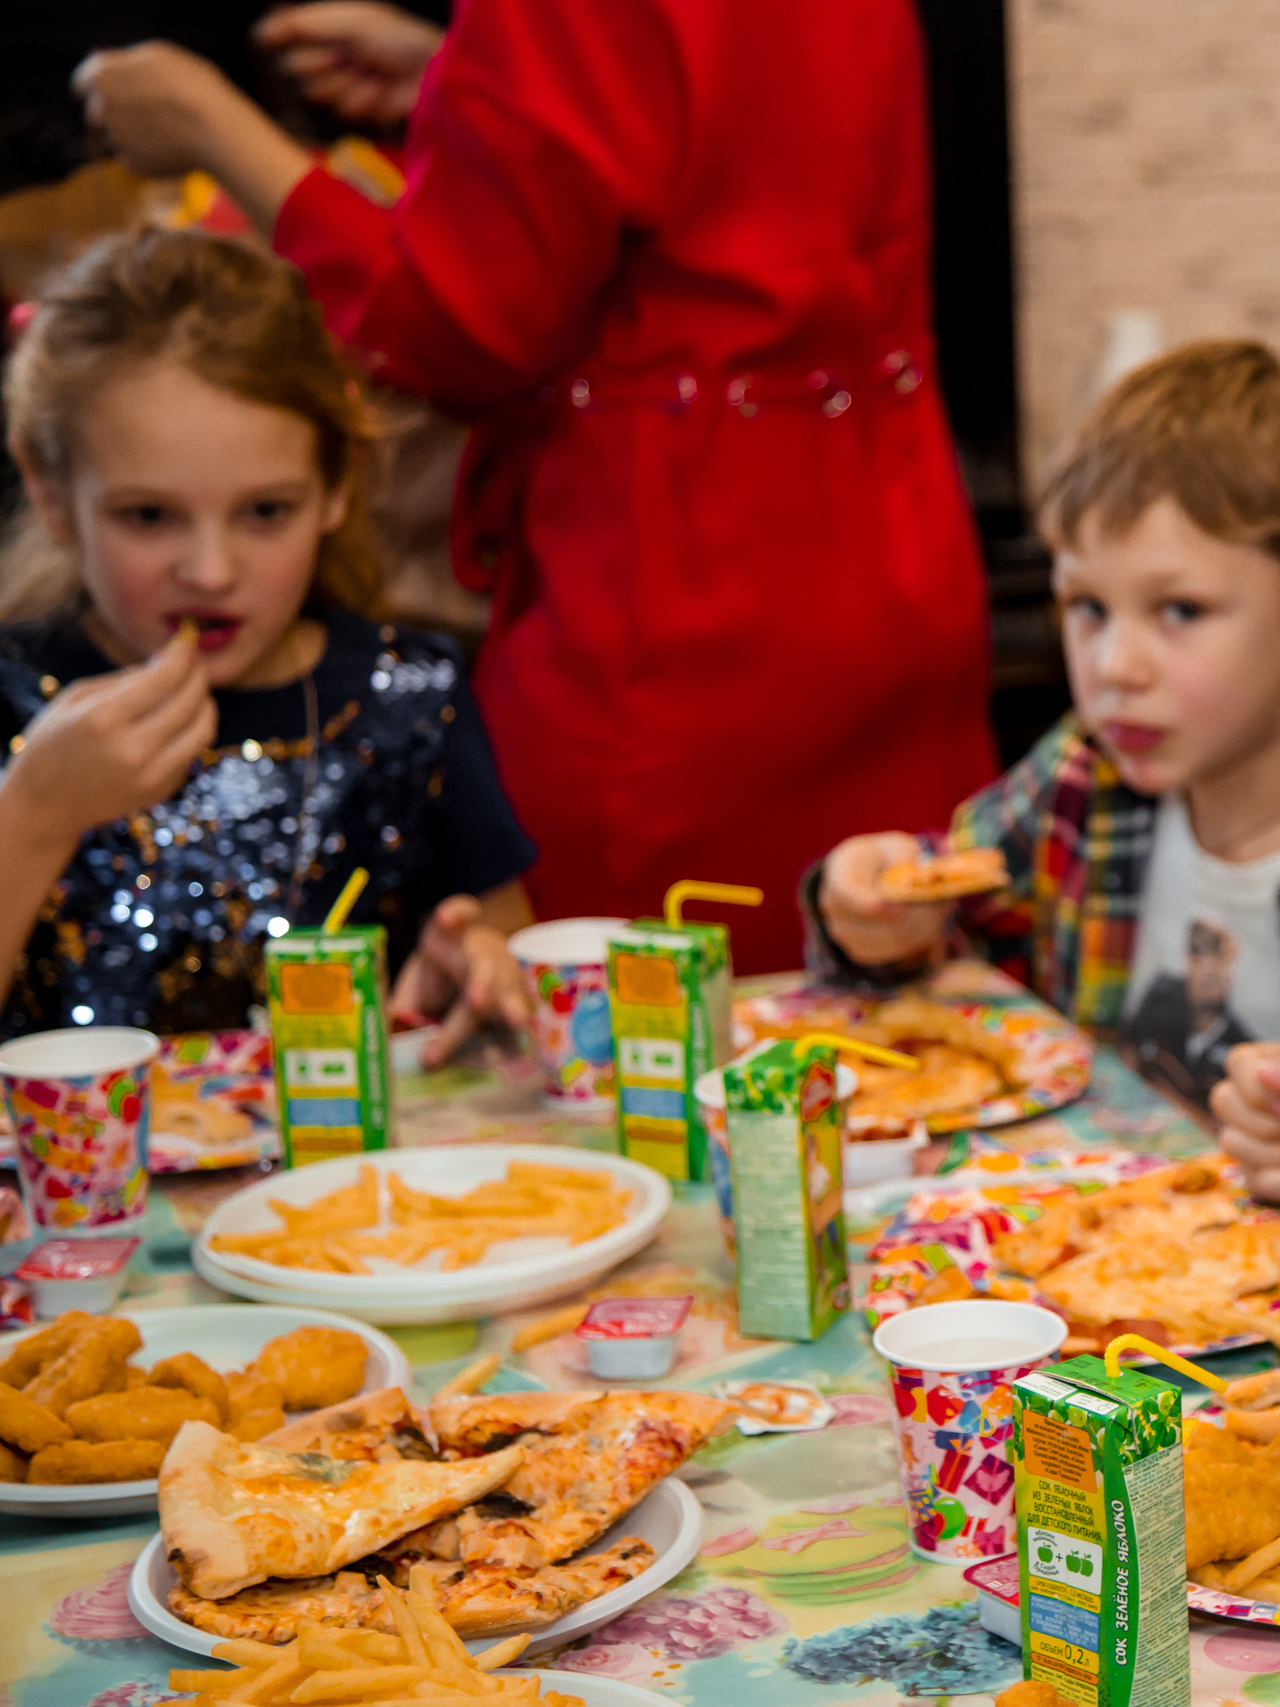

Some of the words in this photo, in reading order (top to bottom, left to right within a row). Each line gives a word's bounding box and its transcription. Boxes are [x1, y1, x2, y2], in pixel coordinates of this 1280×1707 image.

[1032, 1490, 1042, 1501] ИЗ
[1074, 1502, 1095, 1517] ЯБЛОК
[1038, 1480, 1051, 1491] СОК
[1054, 1484, 1087, 1503] ЯБЛОЧНЫЙ
[1026, 1512, 1041, 1525] ДЛЯ
[1041, 1516, 1072, 1533] ДЕТСКОГО
[1033, 1502, 1095, 1528] ВОССТАНОВЛЕННЫЙ
[1111, 1499, 1129, 1564] ЯБЛОКО
[1112, 1566, 1129, 1632] ЗЕЛЁНОЕ
[1039, 1641, 1064, 1657] ОБЪЕМ
[1065, 1644, 1084, 1665] 0,2
[1115, 1637, 1128, 1666] СОК
